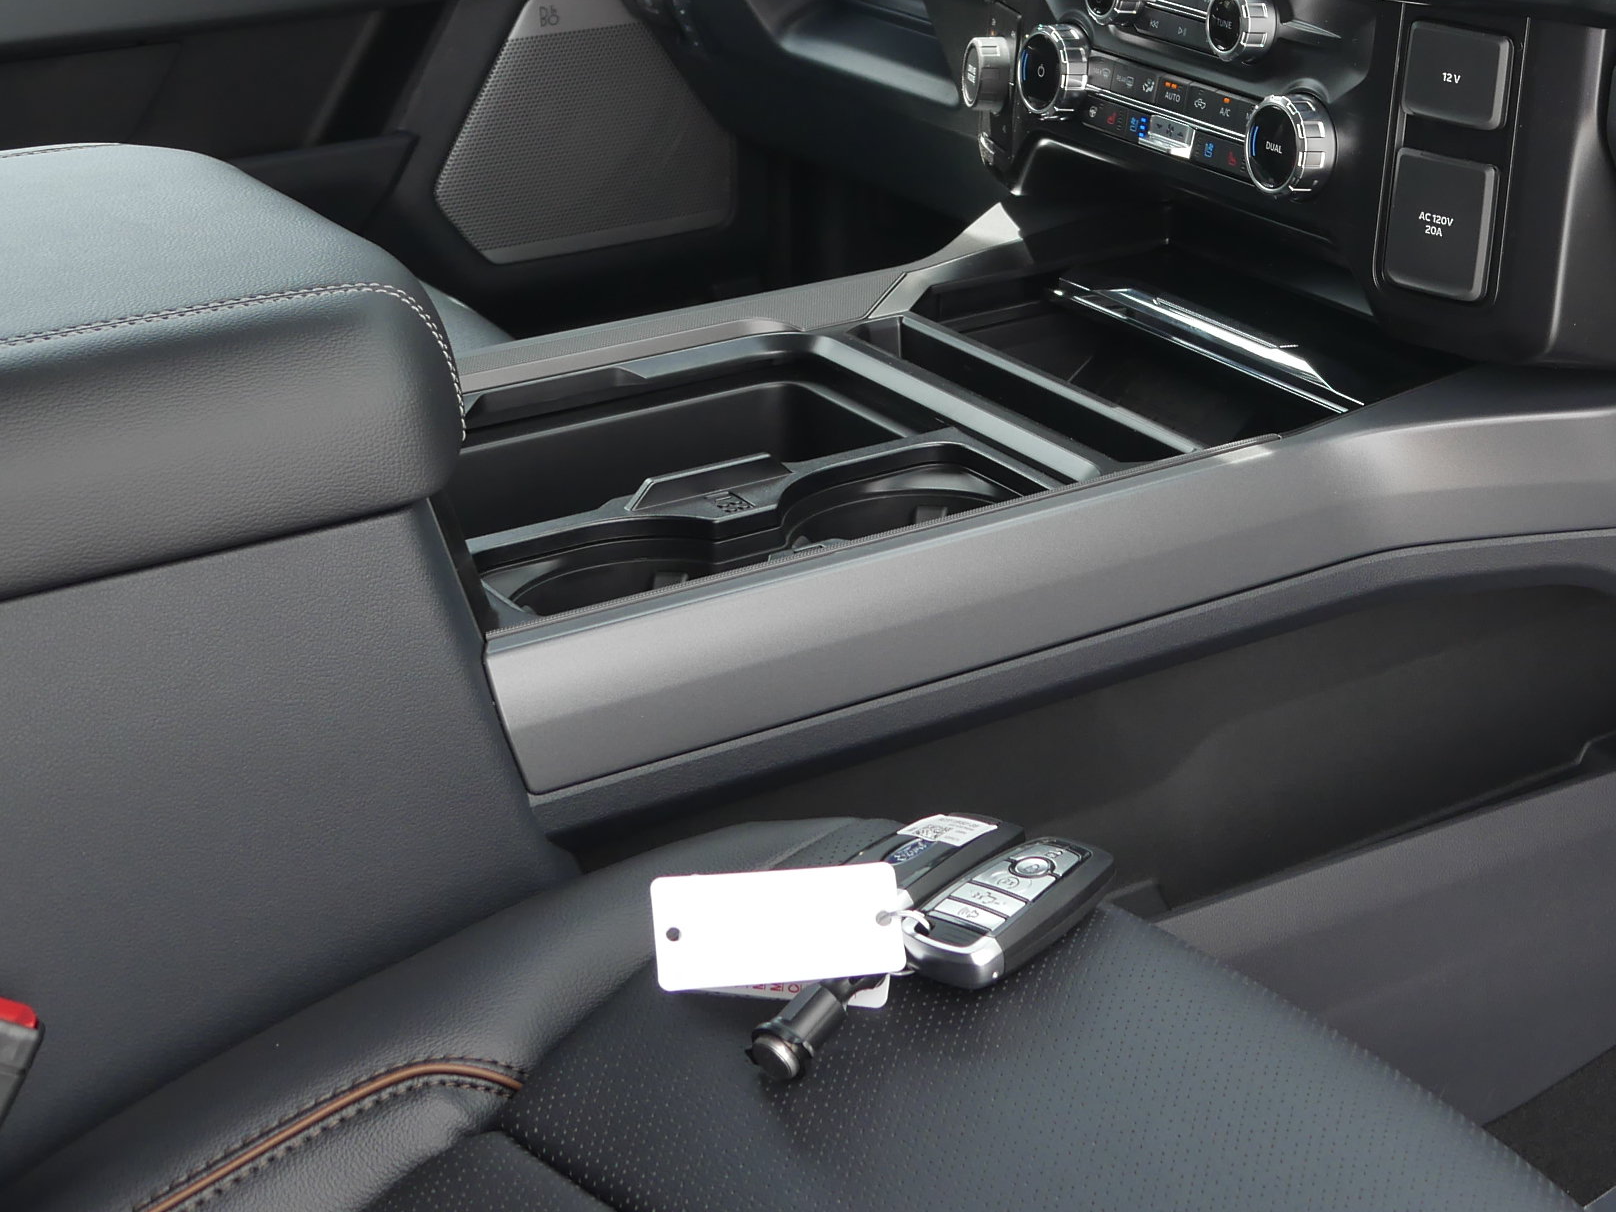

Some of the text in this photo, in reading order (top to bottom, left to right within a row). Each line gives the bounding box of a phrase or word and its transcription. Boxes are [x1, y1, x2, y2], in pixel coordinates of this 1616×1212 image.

[1442, 72, 1462, 84] 12 V
[1164, 91, 1181, 104] AUTO
[1219, 107, 1231, 118] A/C
[1265, 141, 1283, 155] DUAL
[1418, 211, 1454, 227] AC 120V
[1424, 224, 1443, 237] 20A
